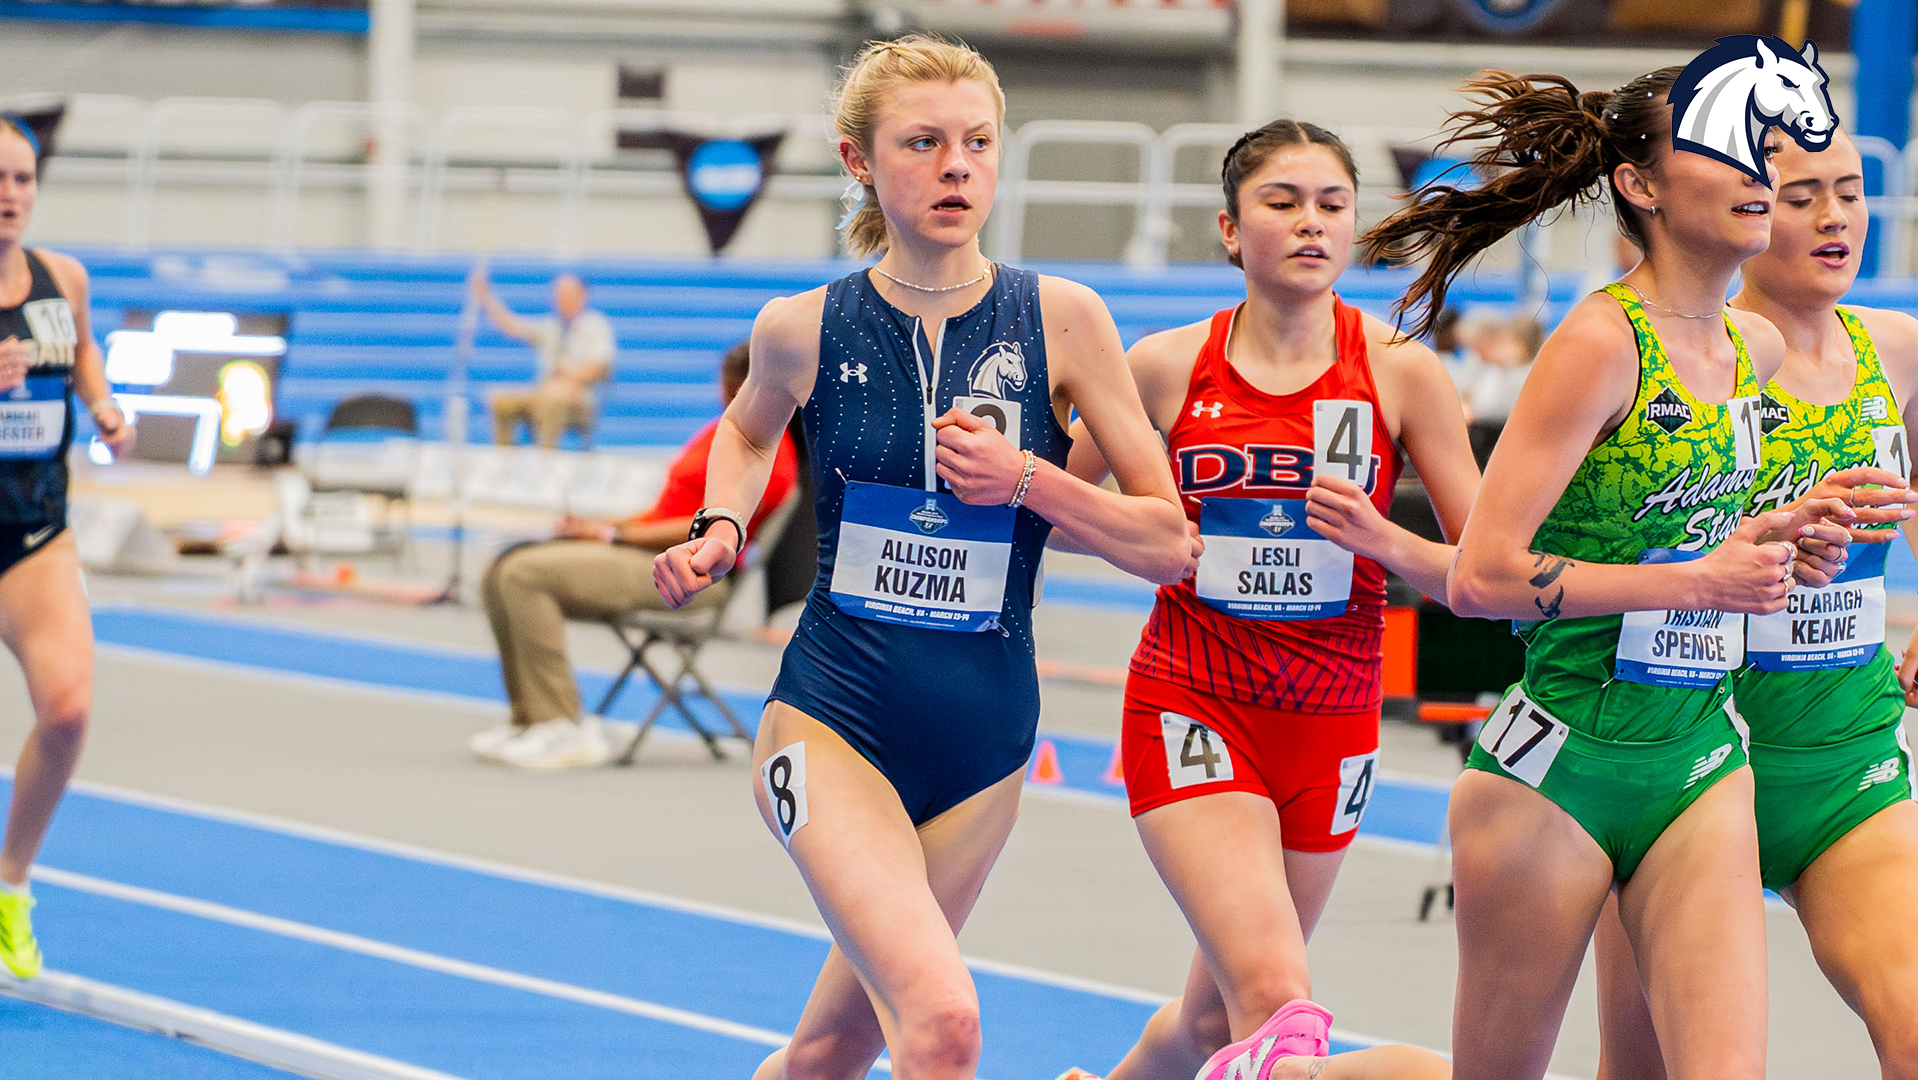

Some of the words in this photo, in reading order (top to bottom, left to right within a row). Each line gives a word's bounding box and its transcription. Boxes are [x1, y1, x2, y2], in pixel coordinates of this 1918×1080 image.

[1649, 403, 1692, 420] RMAC
[1760, 406, 1787, 421] MAC
[1326, 407, 1364, 481] 4
[1177, 443, 1382, 498] DB
[880, 538, 968, 571] ALLISON
[1252, 547, 1300, 567] LESLI
[874, 565, 966, 603] KUZMA
[1237, 570, 1313, 596] SALAS
[864, 600, 893, 612] VIRGINIA
[893, 605, 915, 616] BEACH,
[916, 609, 925, 617] VA
[929, 611, 953, 620] MARCH
[1227, 602, 1253, 611] VIRGINIA
[1786, 589, 1863, 614] CLARAGH
[1791, 615, 1857, 645] KEANE
[1652, 629, 1727, 662] SPENCE
[1781, 654, 1806, 662] VIRGINIA
[1647, 666, 1671, 676] VIRGINIA
[1490, 699, 1555, 769] 17
[1180, 724, 1222, 779] 4
[769, 755, 797, 836] 8
[1344, 758, 1375, 824] 4
